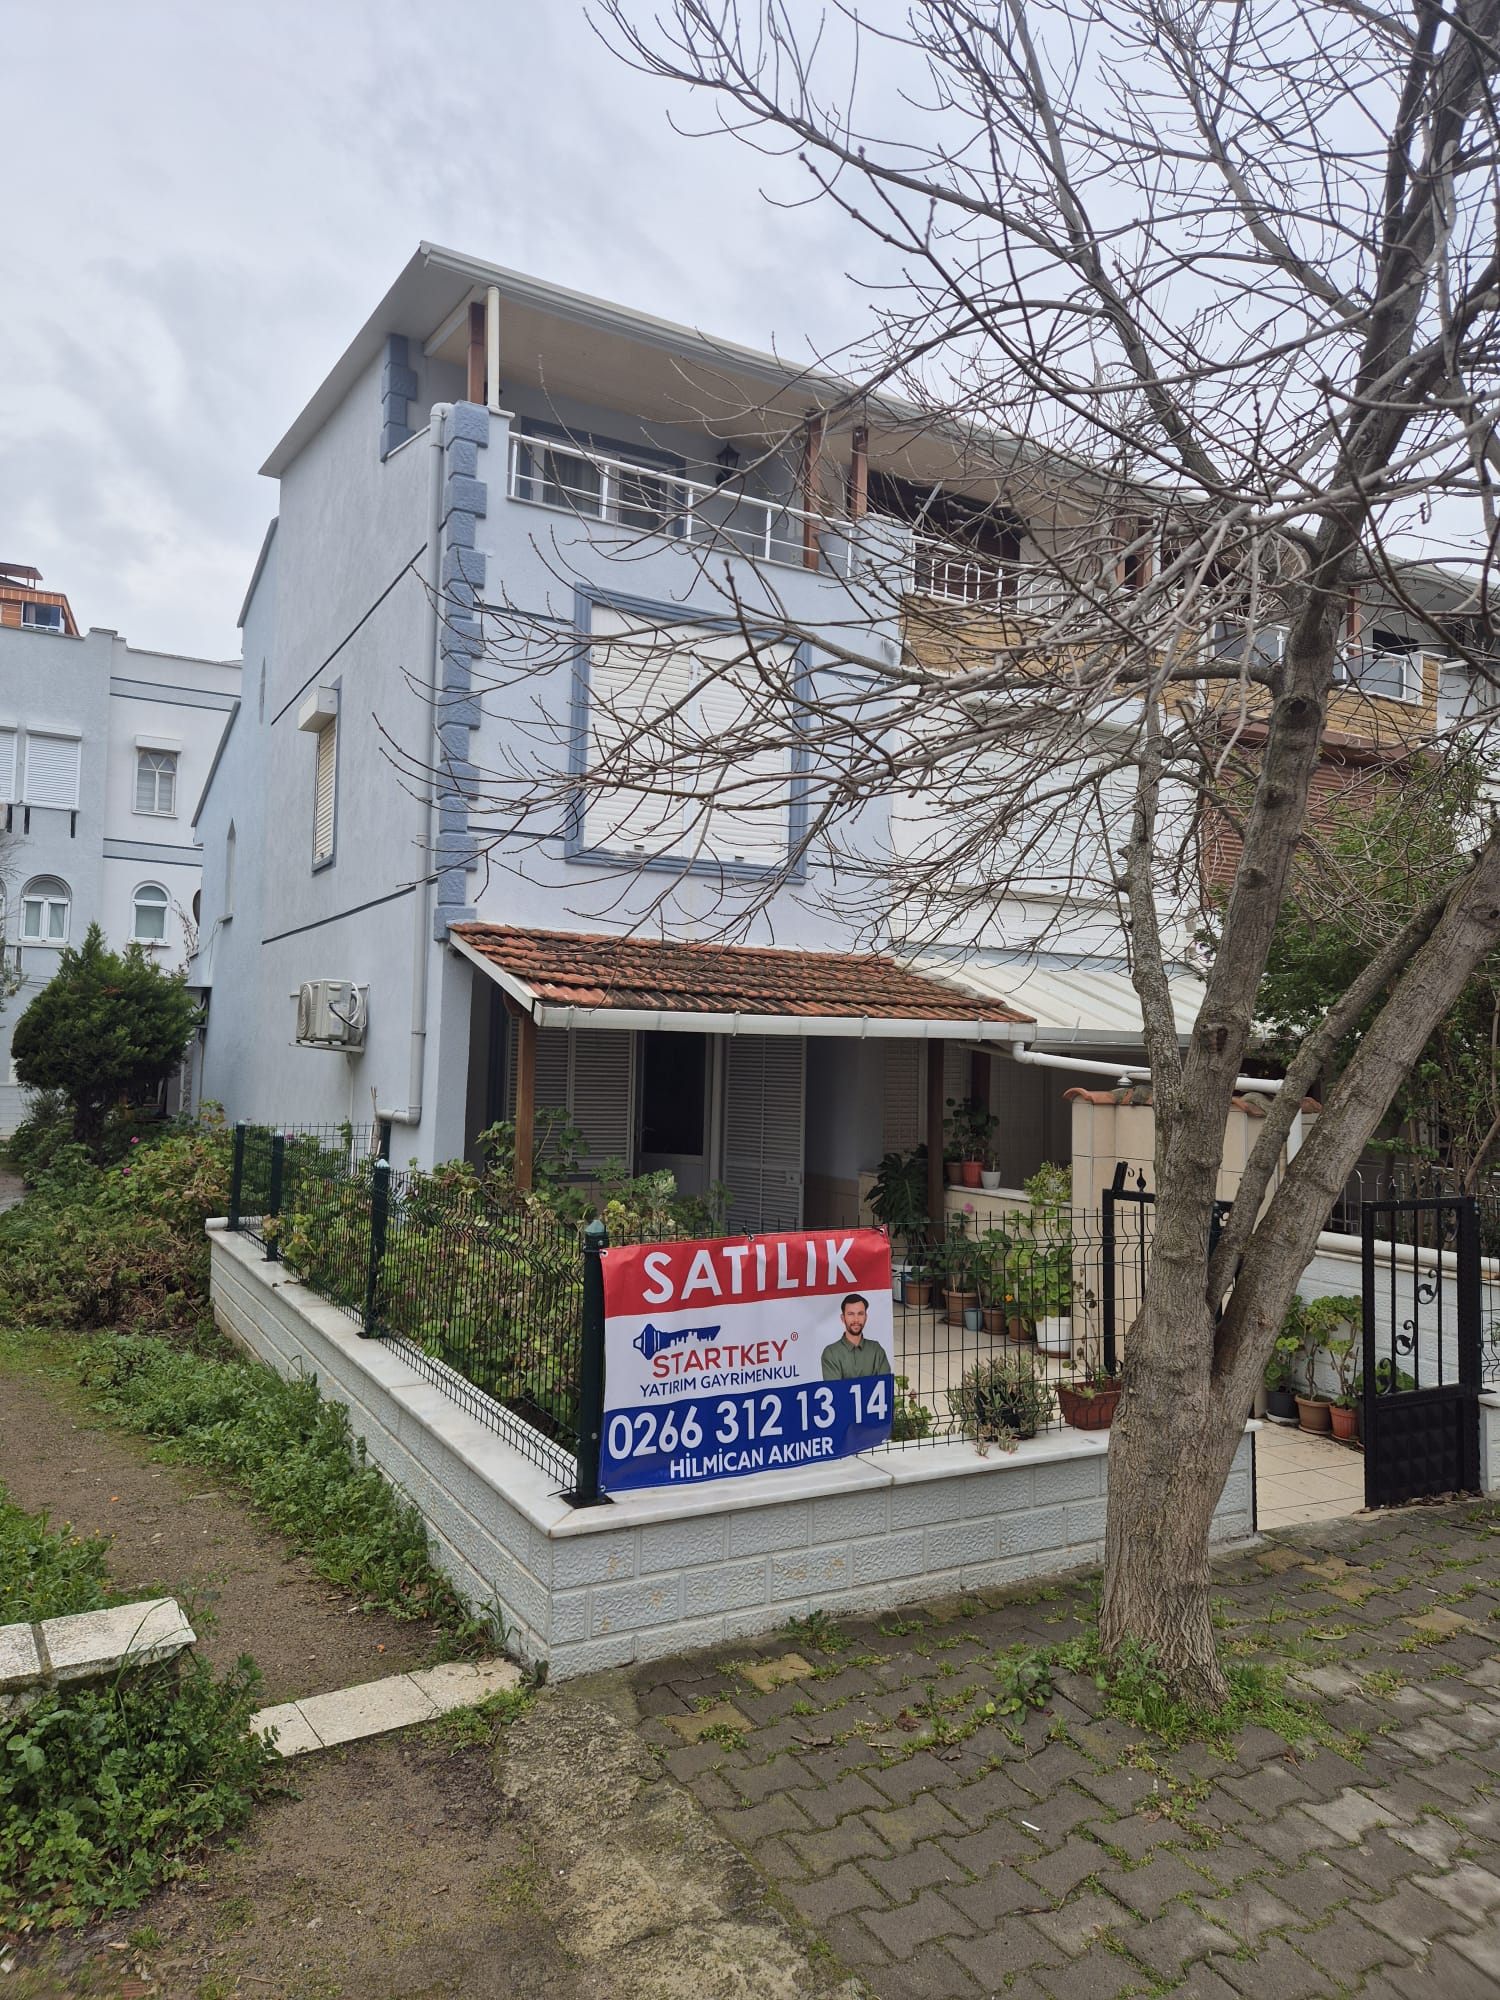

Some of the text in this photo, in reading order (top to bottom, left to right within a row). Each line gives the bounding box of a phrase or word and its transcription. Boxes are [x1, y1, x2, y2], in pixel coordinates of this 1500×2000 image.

[643, 1237, 858, 1304] SATILIK
[652, 1339, 788, 1378] STARTKEY
[640, 1364, 800, 1398] YATIRIM GAYRİMENKUL
[608, 1380, 888, 1460] 0266 312 13 14
[670, 1436, 834, 1479] HİLMİCAN AKINER
